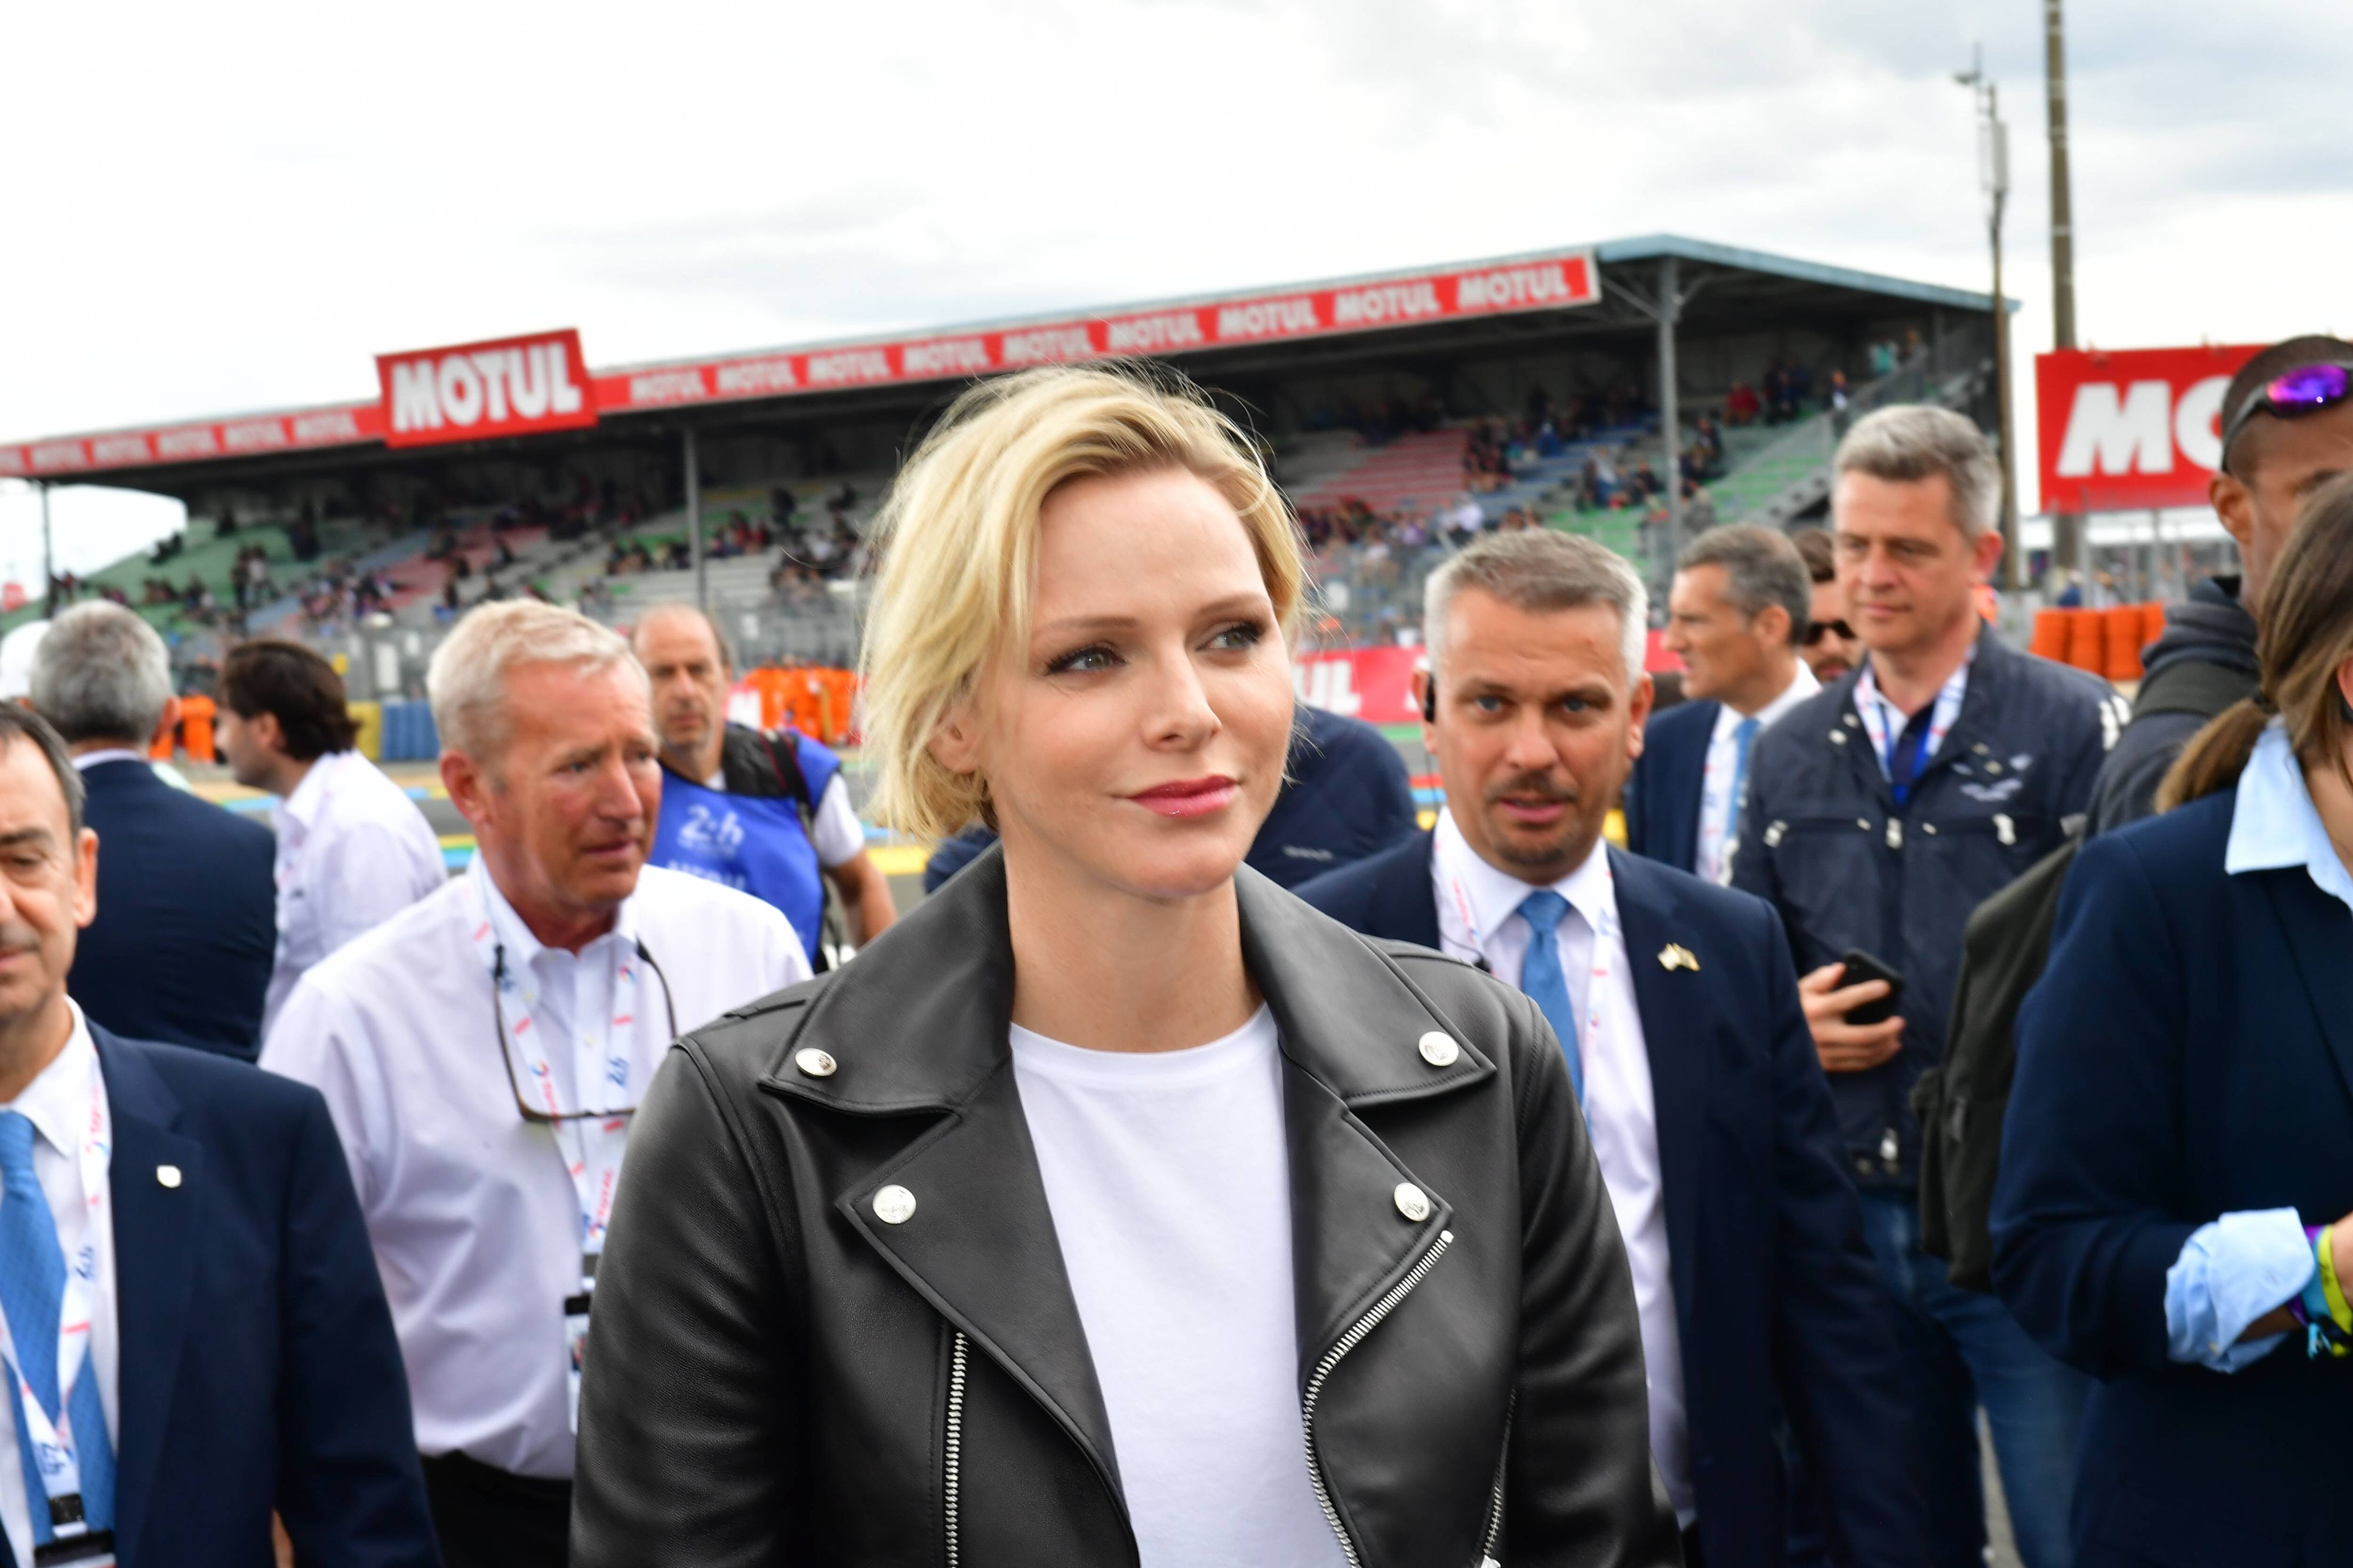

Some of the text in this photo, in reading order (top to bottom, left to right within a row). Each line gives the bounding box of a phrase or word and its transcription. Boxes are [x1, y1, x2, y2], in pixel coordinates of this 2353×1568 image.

[905, 340, 989, 373] MOTUL
[1002, 326, 1092, 361] MOTUL
[1108, 312, 1204, 349] MOTUL
[1219, 296, 1318, 336] MOTUL
[1335, 281, 1441, 322] MOTUL
[1458, 265, 1569, 308] MOTUL
[391, 342, 582, 433] MOTUL
